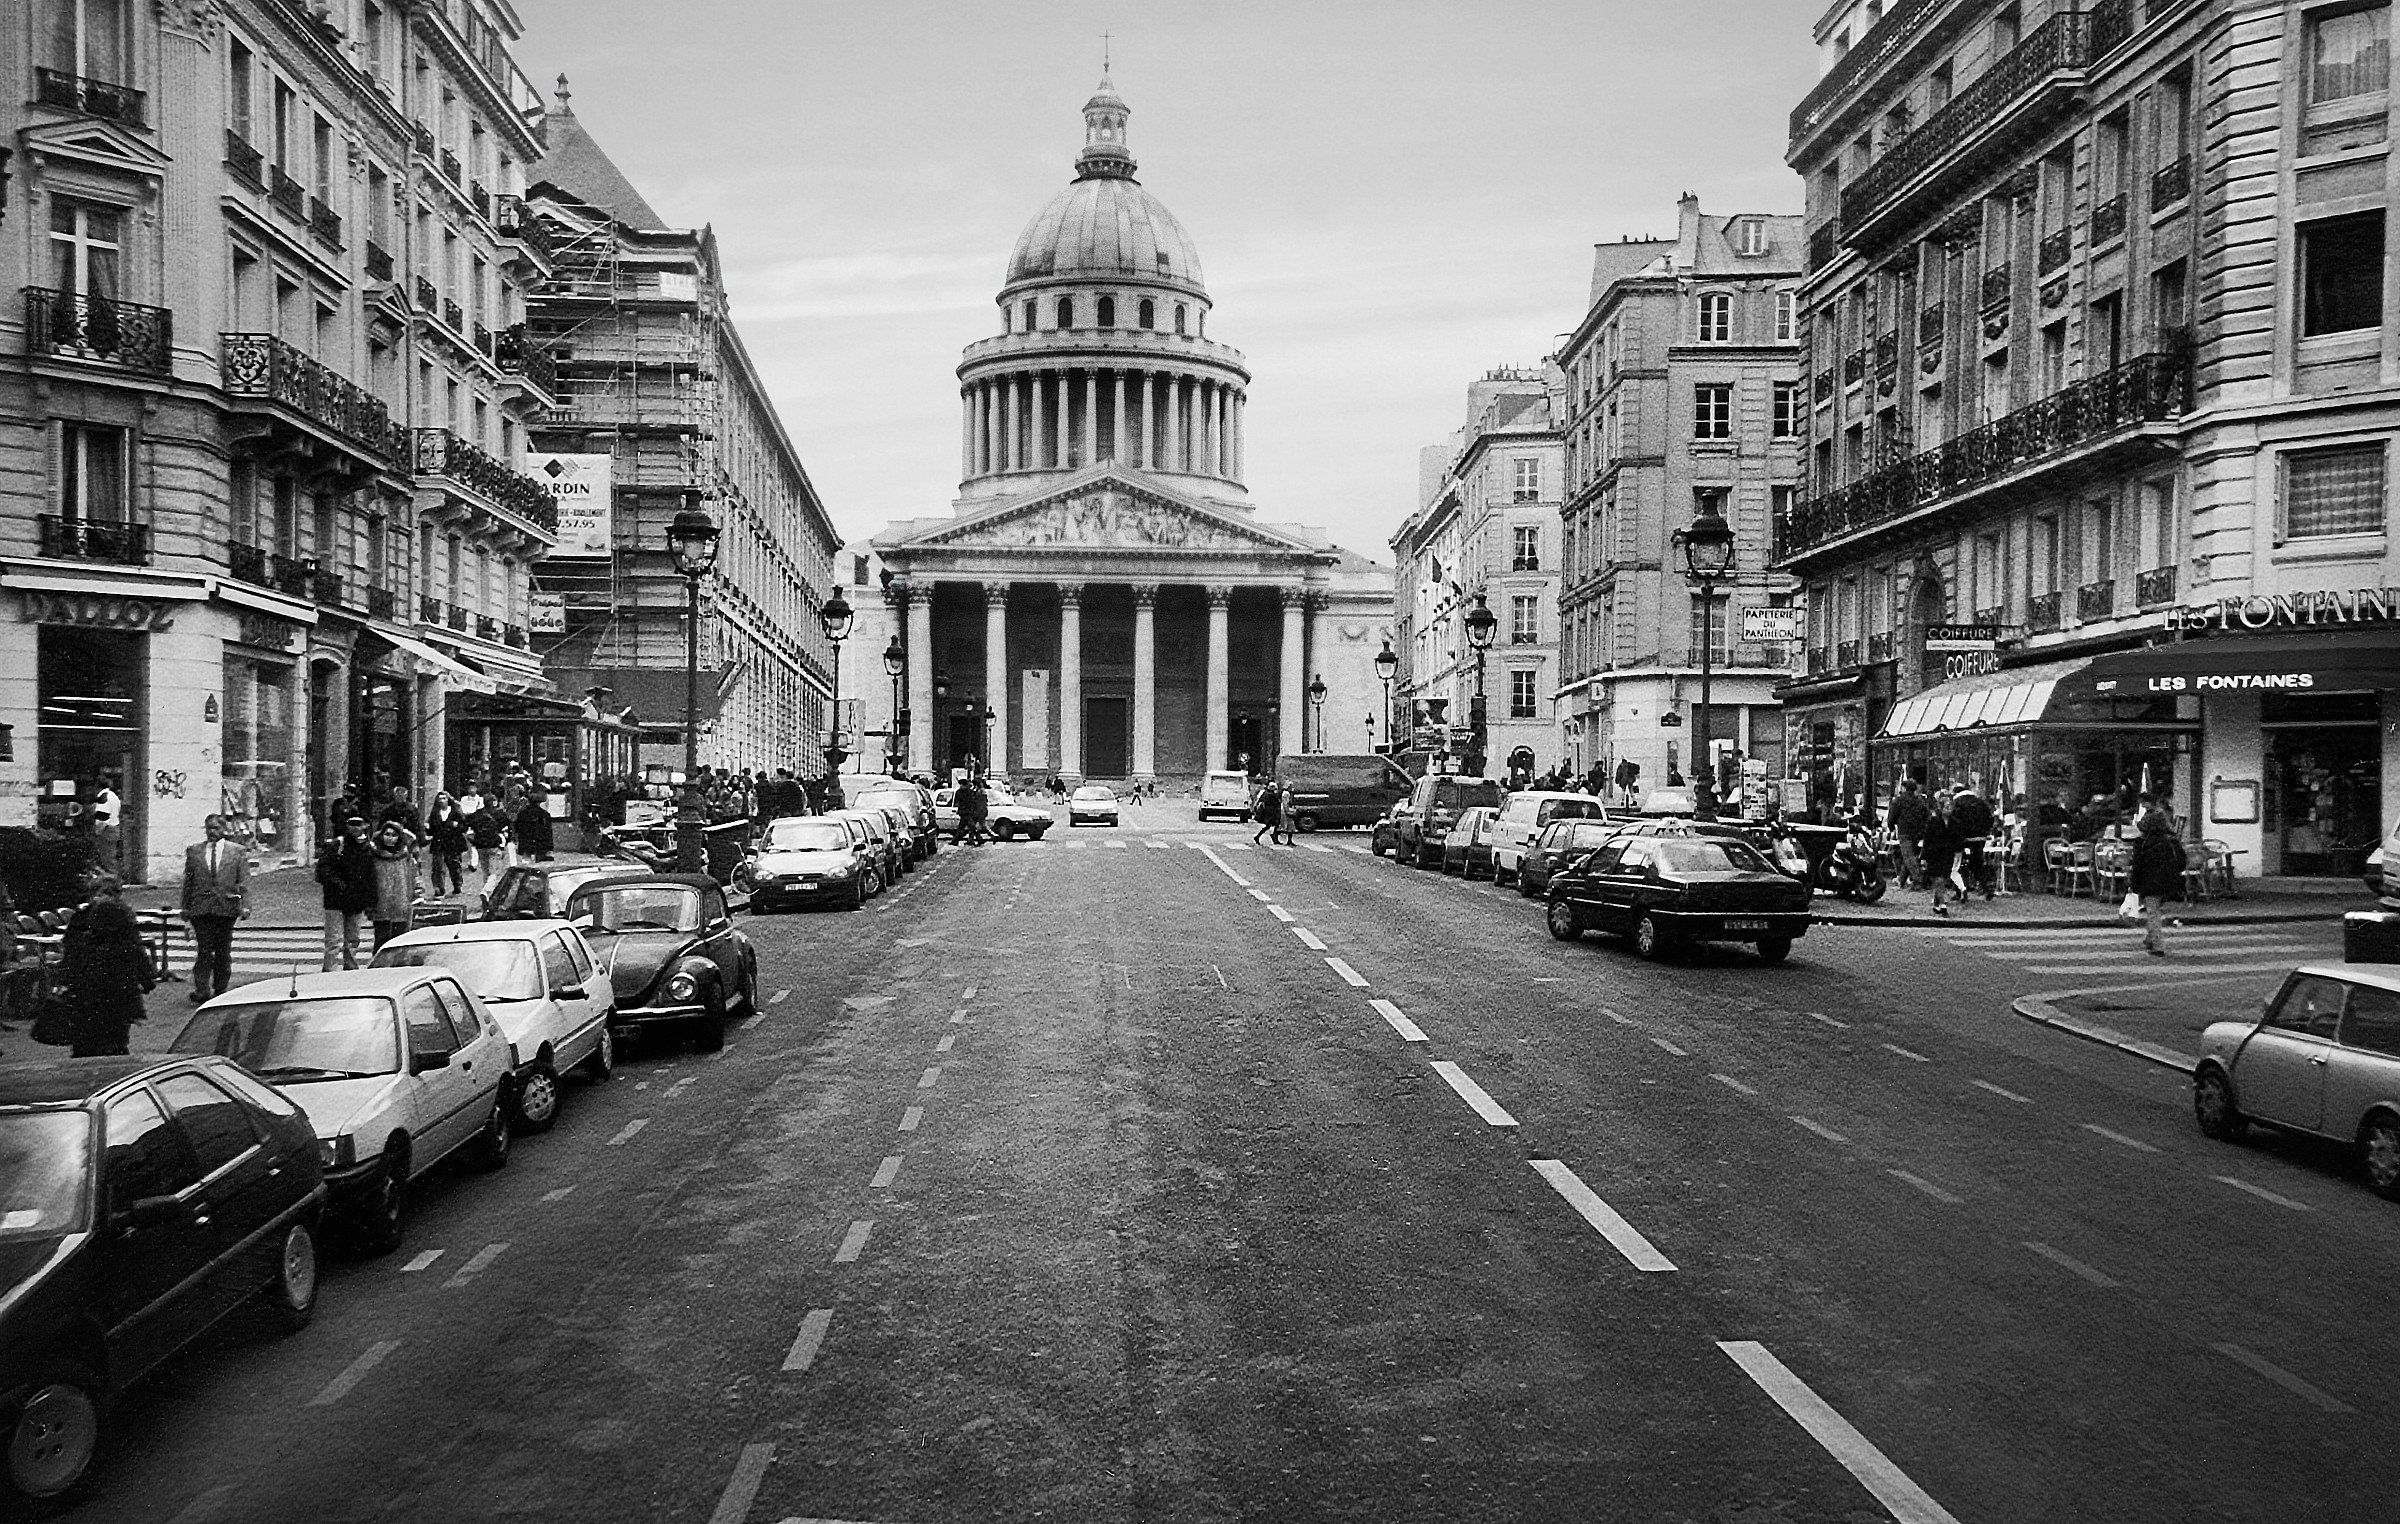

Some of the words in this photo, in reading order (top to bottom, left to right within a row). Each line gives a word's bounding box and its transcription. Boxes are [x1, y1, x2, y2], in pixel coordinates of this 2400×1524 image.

[18, 596, 174, 634] DALLOZ
[1745, 610, 1794, 619] PAPETERIE
[2163, 606, 2208, 630] LES
[2216, 587, 2400, 629] FONTAIN
[1763, 620, 1776, 628] DU
[1927, 627, 1993, 640] COIFFURE
[1945, 651, 1999, 679] COIFFURE
[2148, 676, 2186, 691] LES
[2196, 673, 2313, 690] FONTAINES
